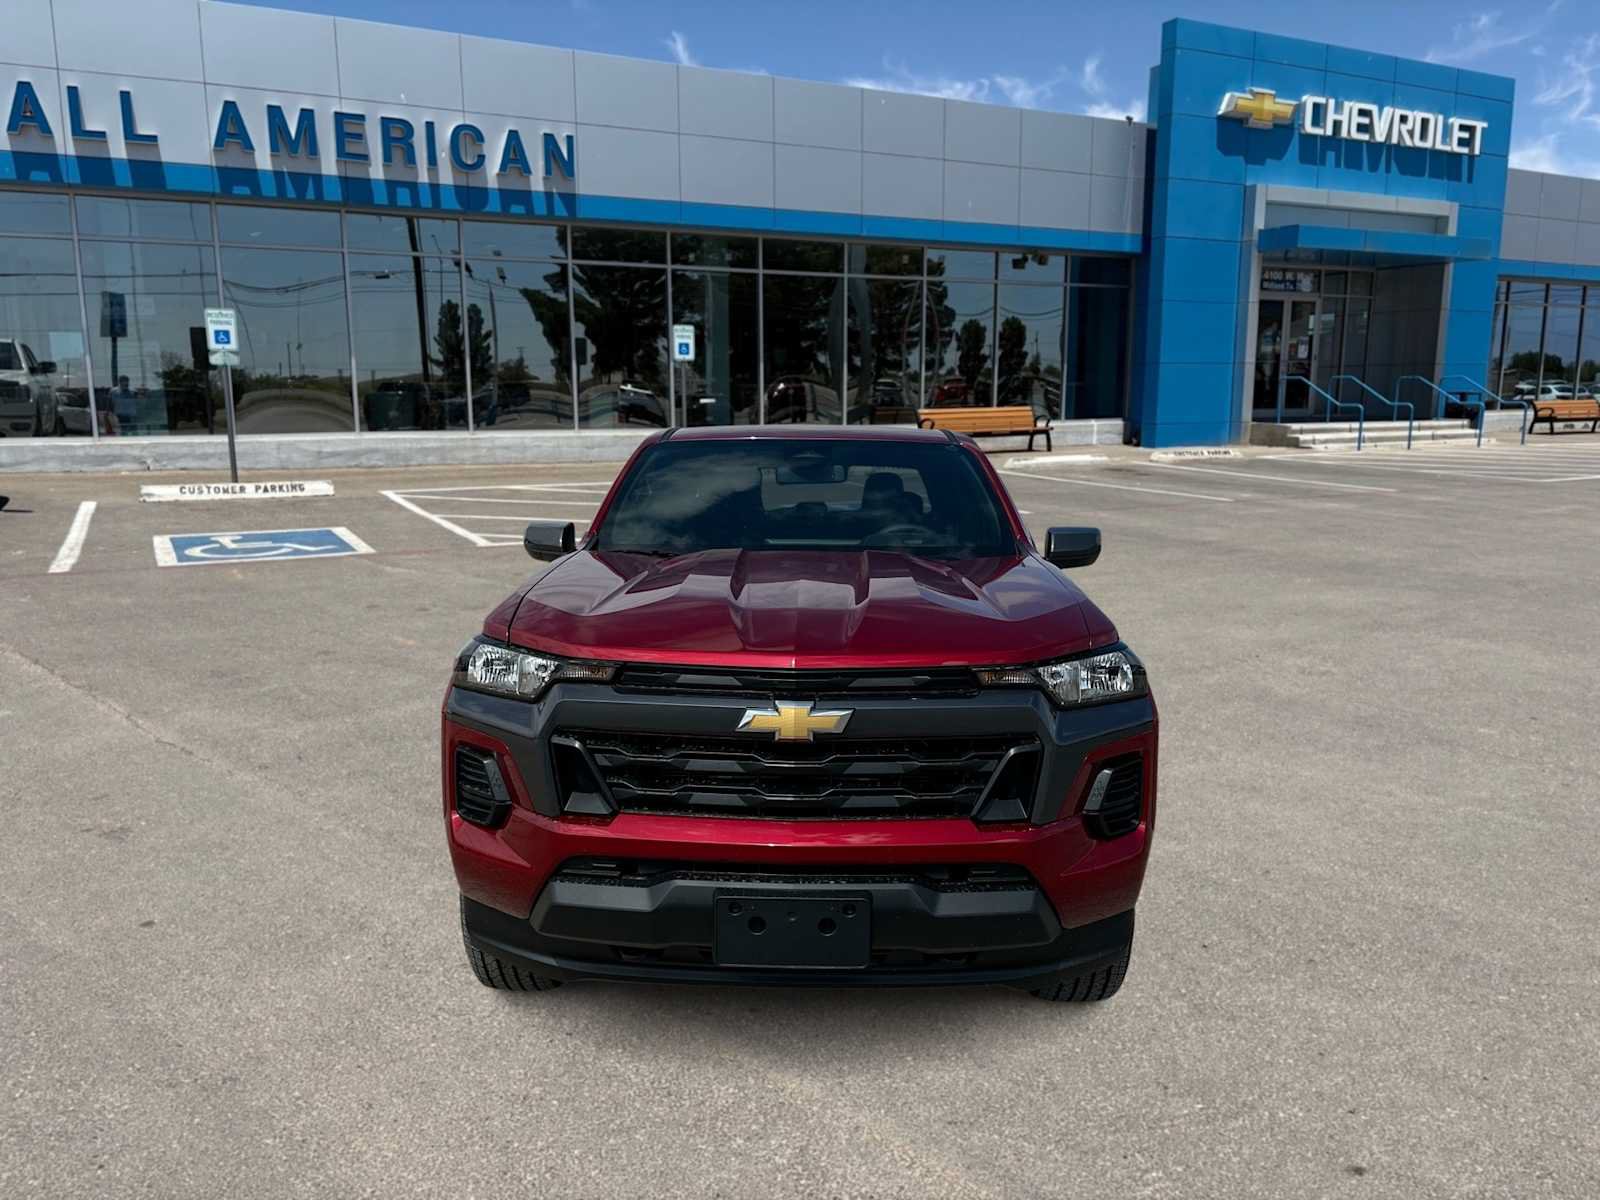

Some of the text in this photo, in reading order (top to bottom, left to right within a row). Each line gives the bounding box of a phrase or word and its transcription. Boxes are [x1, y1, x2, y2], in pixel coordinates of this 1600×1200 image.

[6, 80, 576, 178] ALL AMERICAN
[1301, 94, 1488, 156] CHEVROLET
[179, 483, 306, 495] CUSTOMER PARKING
